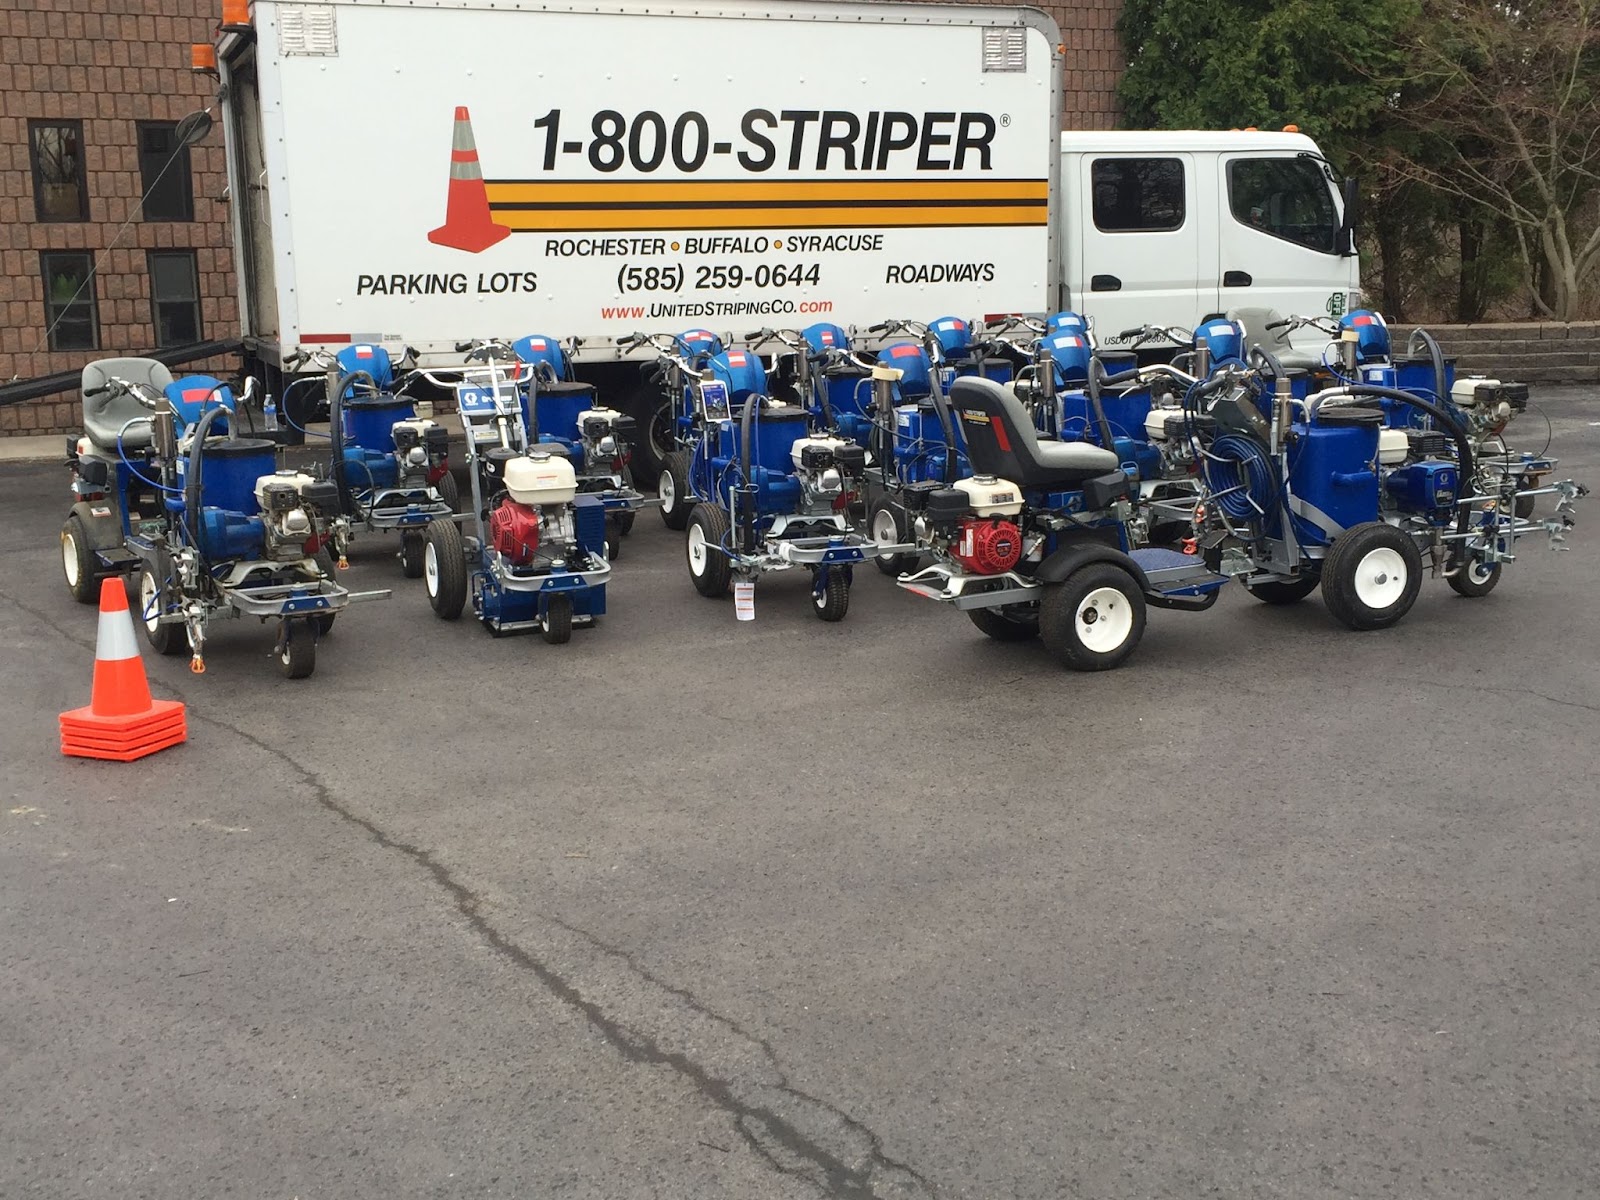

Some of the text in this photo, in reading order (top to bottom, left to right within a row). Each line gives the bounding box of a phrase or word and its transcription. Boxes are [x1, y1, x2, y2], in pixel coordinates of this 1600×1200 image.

[545, 235, 884, 256] ROCHESTER BUFFALO SYRACUSE
[357, 272, 538, 295] PARKING LOTS
[617, 263, 821, 294] (585) 259-0644
[885, 263, 995, 284] ROADWAYS
[1333, 294, 1342, 314] OFF
[1104, 335, 1132, 346] USDOT
